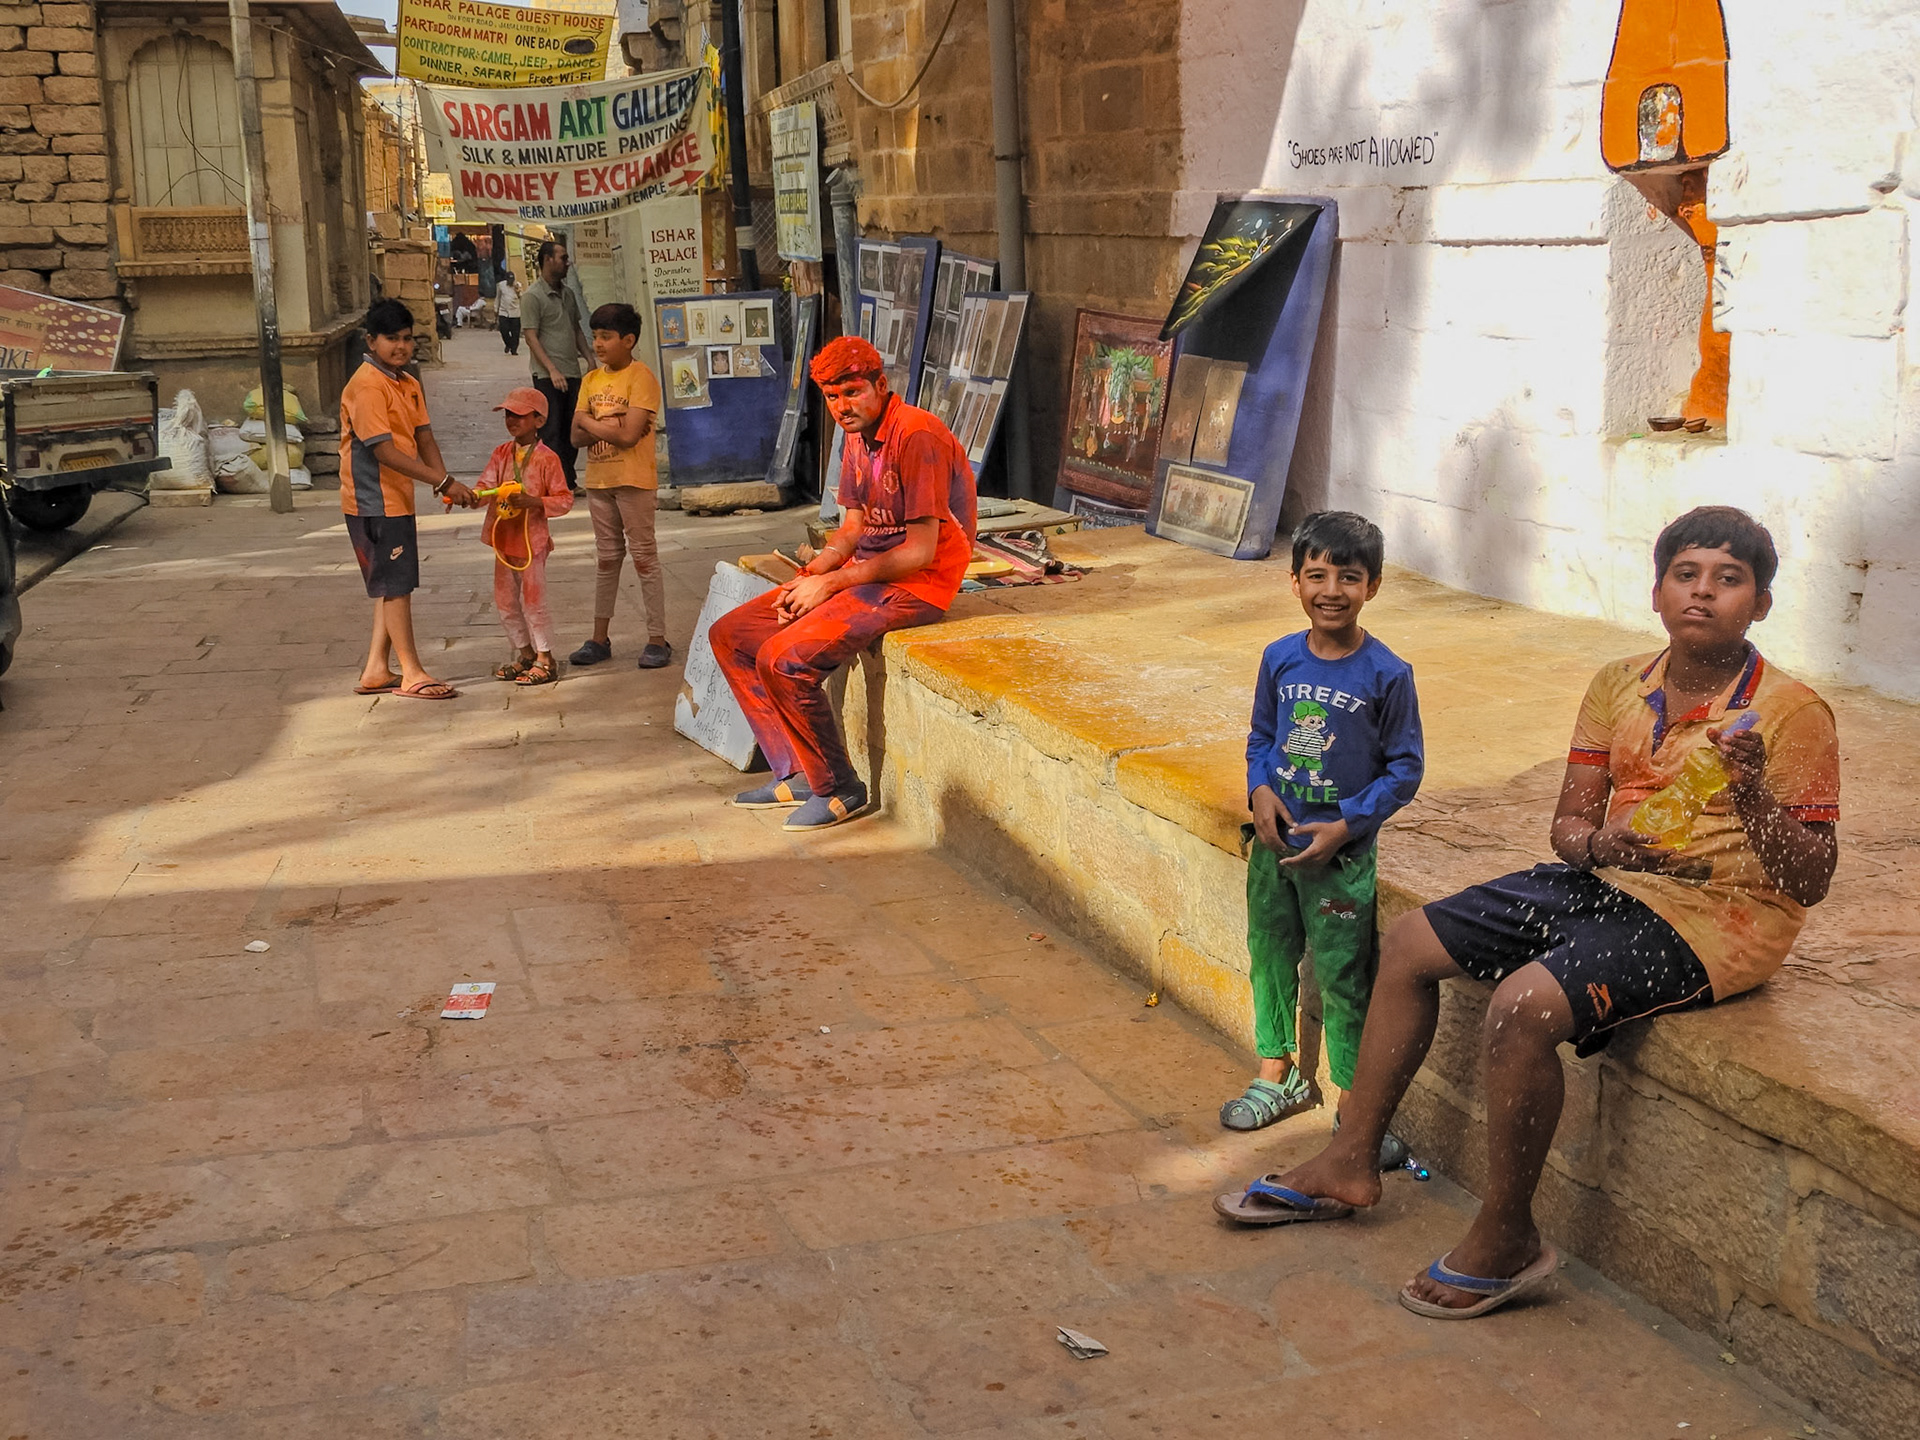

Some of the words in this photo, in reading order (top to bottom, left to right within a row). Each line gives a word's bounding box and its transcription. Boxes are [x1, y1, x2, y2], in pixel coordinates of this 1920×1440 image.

[459, 2, 510, 20] PALACE
[516, 9, 561, 26] GUEST
[563, 14, 605, 30] HOUSE
[403, 36, 456, 58] CONTRACT
[474, 28, 508, 45] MATRI
[515, 34, 536, 49] ONE
[538, 36, 560, 51] BAD
[472, 65, 516, 82] SAFARI
[443, 100, 552, 142] SARGAM
[558, 95, 608, 142] ART
[612, 67, 702, 131] GALLERY
[461, 145, 496, 165] SILK
[501, 149, 516, 167] &
[518, 141, 607, 165] MINIATURE
[618, 112, 688, 154] PAINTING
[1328, 147, 1343, 164] ARE
[1345, 139, 1366, 162] NOT
[460, 169, 560, 201] MONEY
[574, 132, 702, 198] EXCHANGE
[519, 204, 546, 219] NEAR
[550, 199, 608, 218] LAXMINATH
[624, 182, 667, 205] TEMPLE
[651, 228, 696, 243] ISHAR
[649, 246, 698, 264] PALACE
[1280, 683, 1367, 714] STREET
[1278, 778, 1340, 803] TYLE
